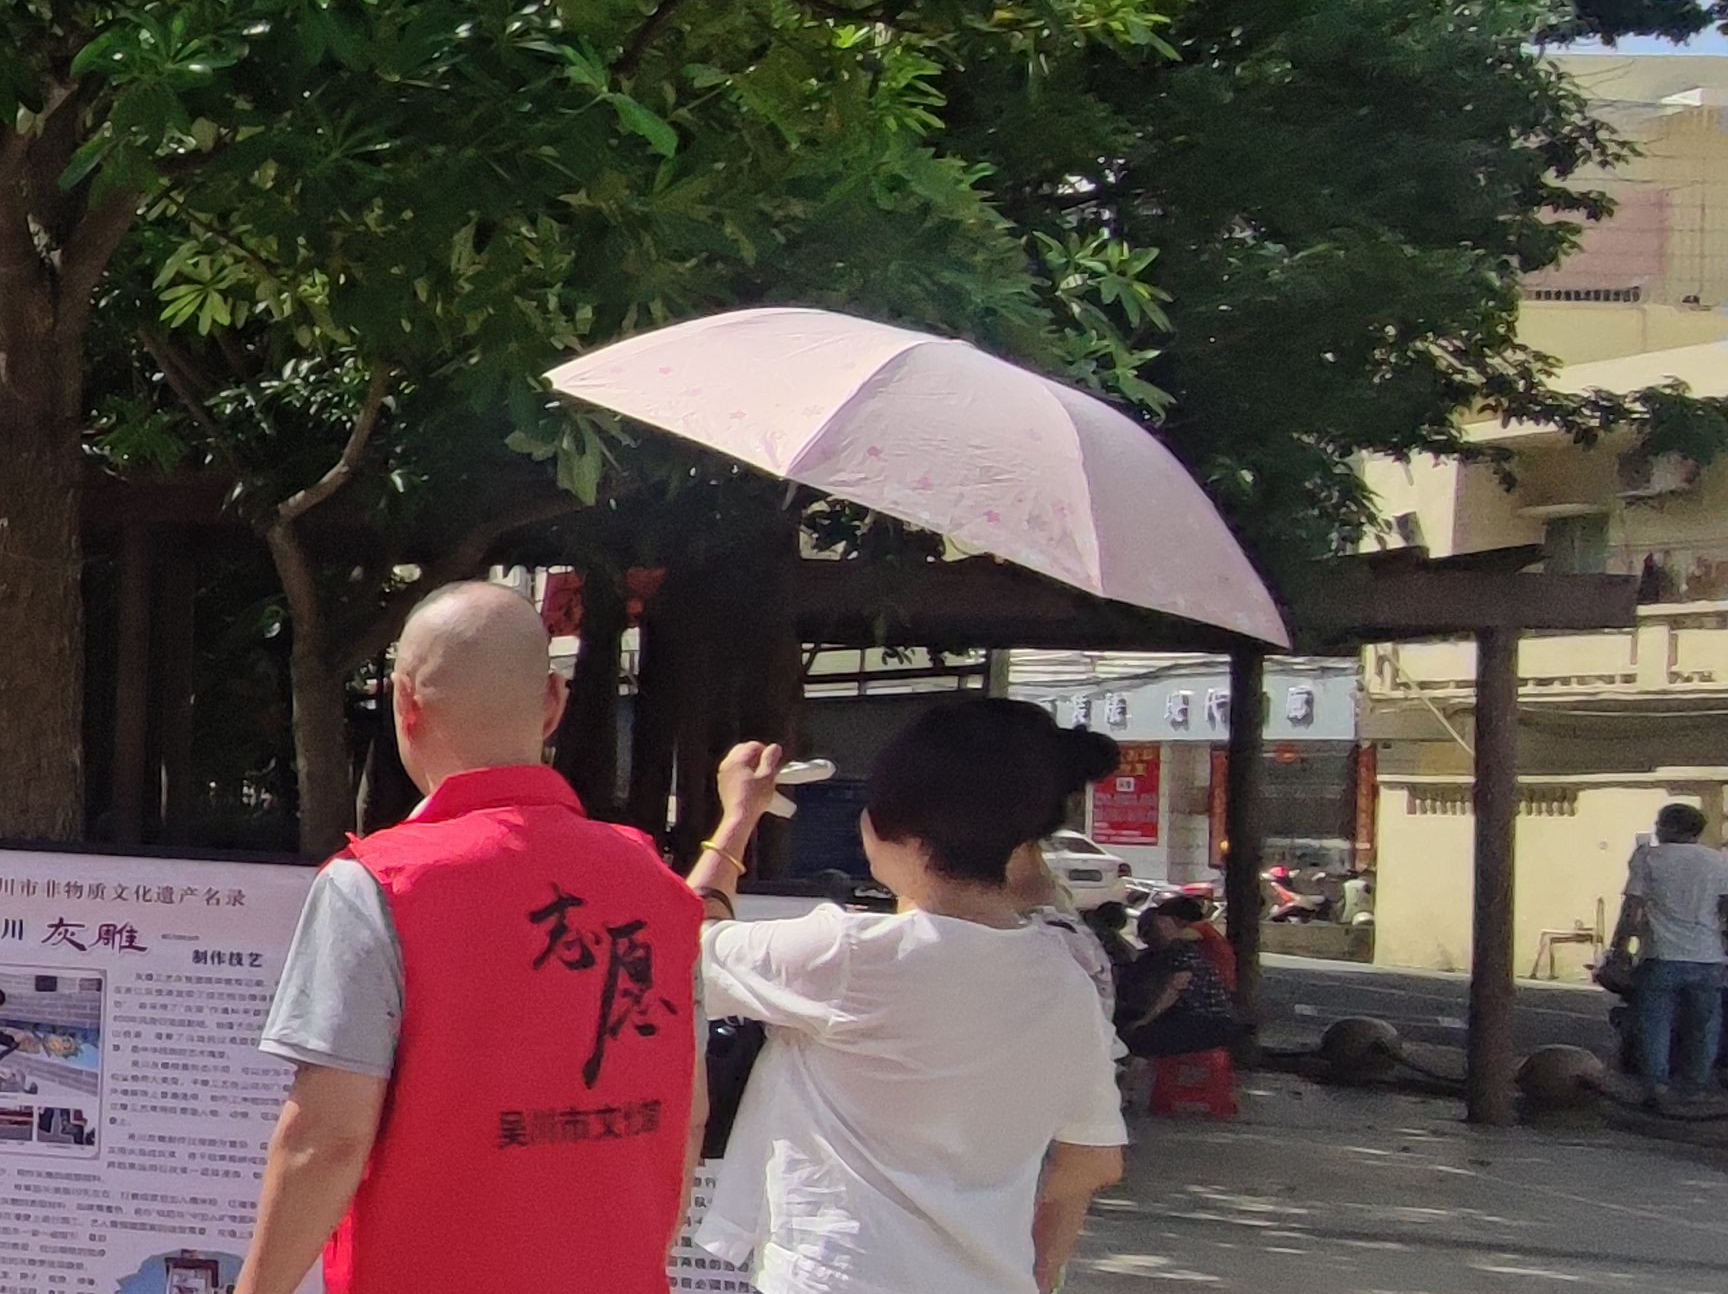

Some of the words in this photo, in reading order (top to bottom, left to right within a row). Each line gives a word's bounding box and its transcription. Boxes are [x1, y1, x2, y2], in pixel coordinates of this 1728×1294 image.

[41, 916, 148, 955] 灰雕
[191, 948, 264, 968] 制作技艺
